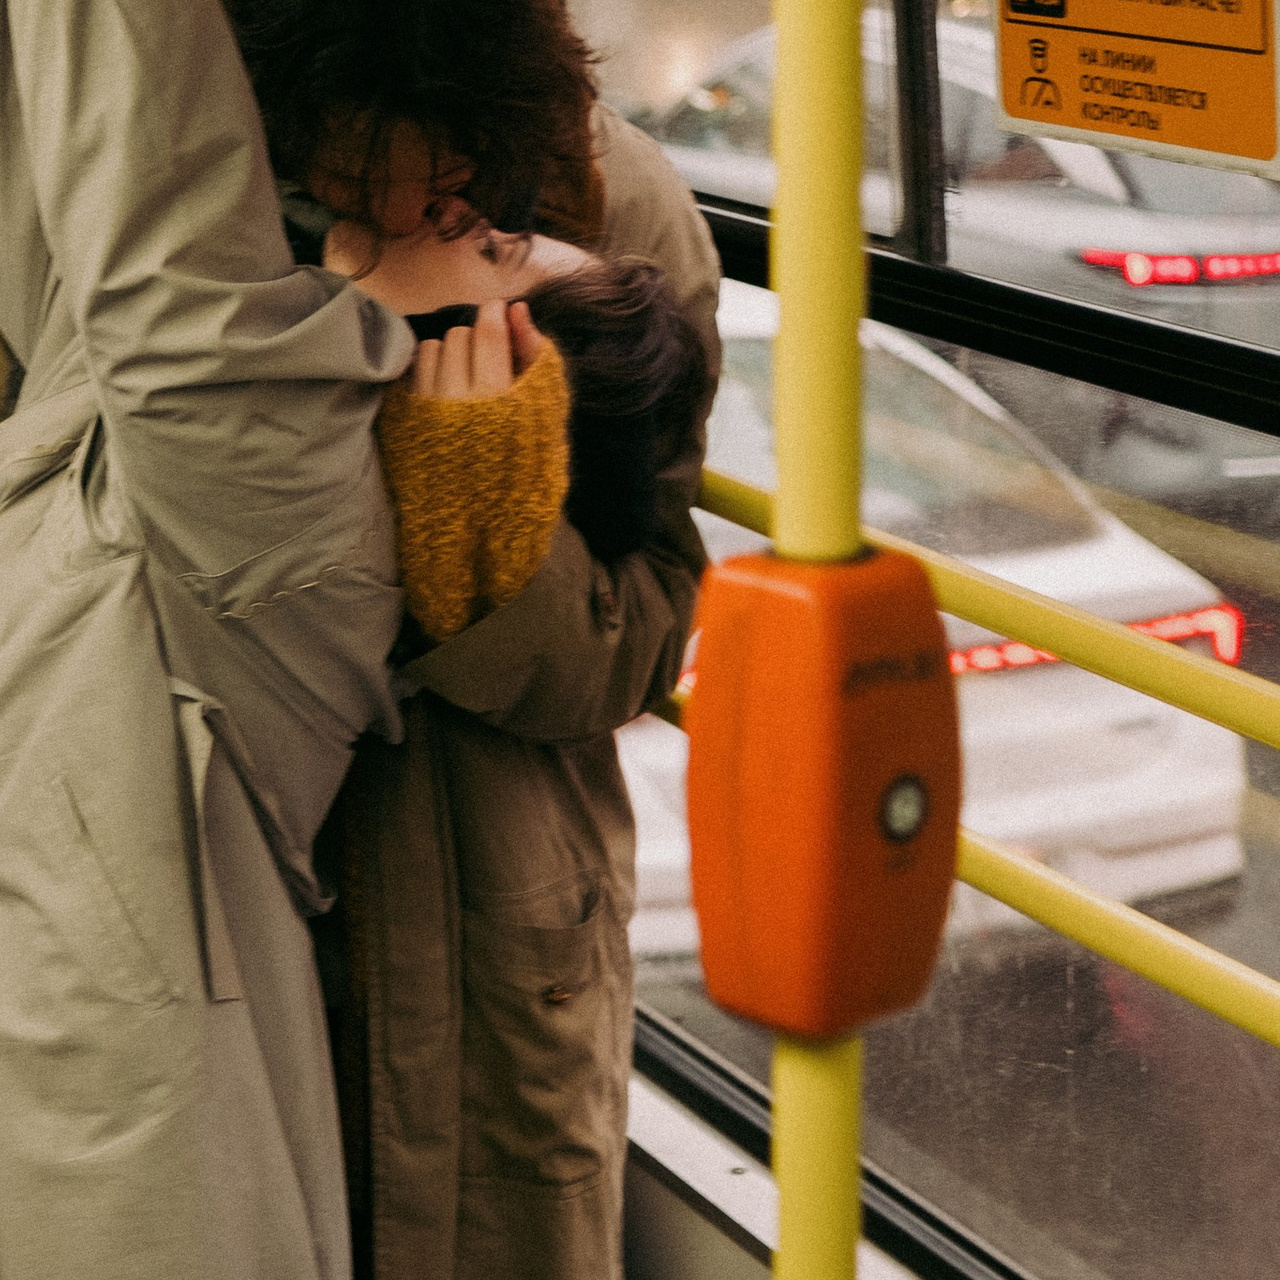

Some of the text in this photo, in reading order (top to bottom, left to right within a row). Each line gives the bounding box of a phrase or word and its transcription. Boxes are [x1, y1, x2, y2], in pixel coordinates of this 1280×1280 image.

[1078, 47, 1157, 74] НА ЛИНИИ
[1080, 73, 1208, 111] ОСУЩЕСТВЛЯЕТСЯ
